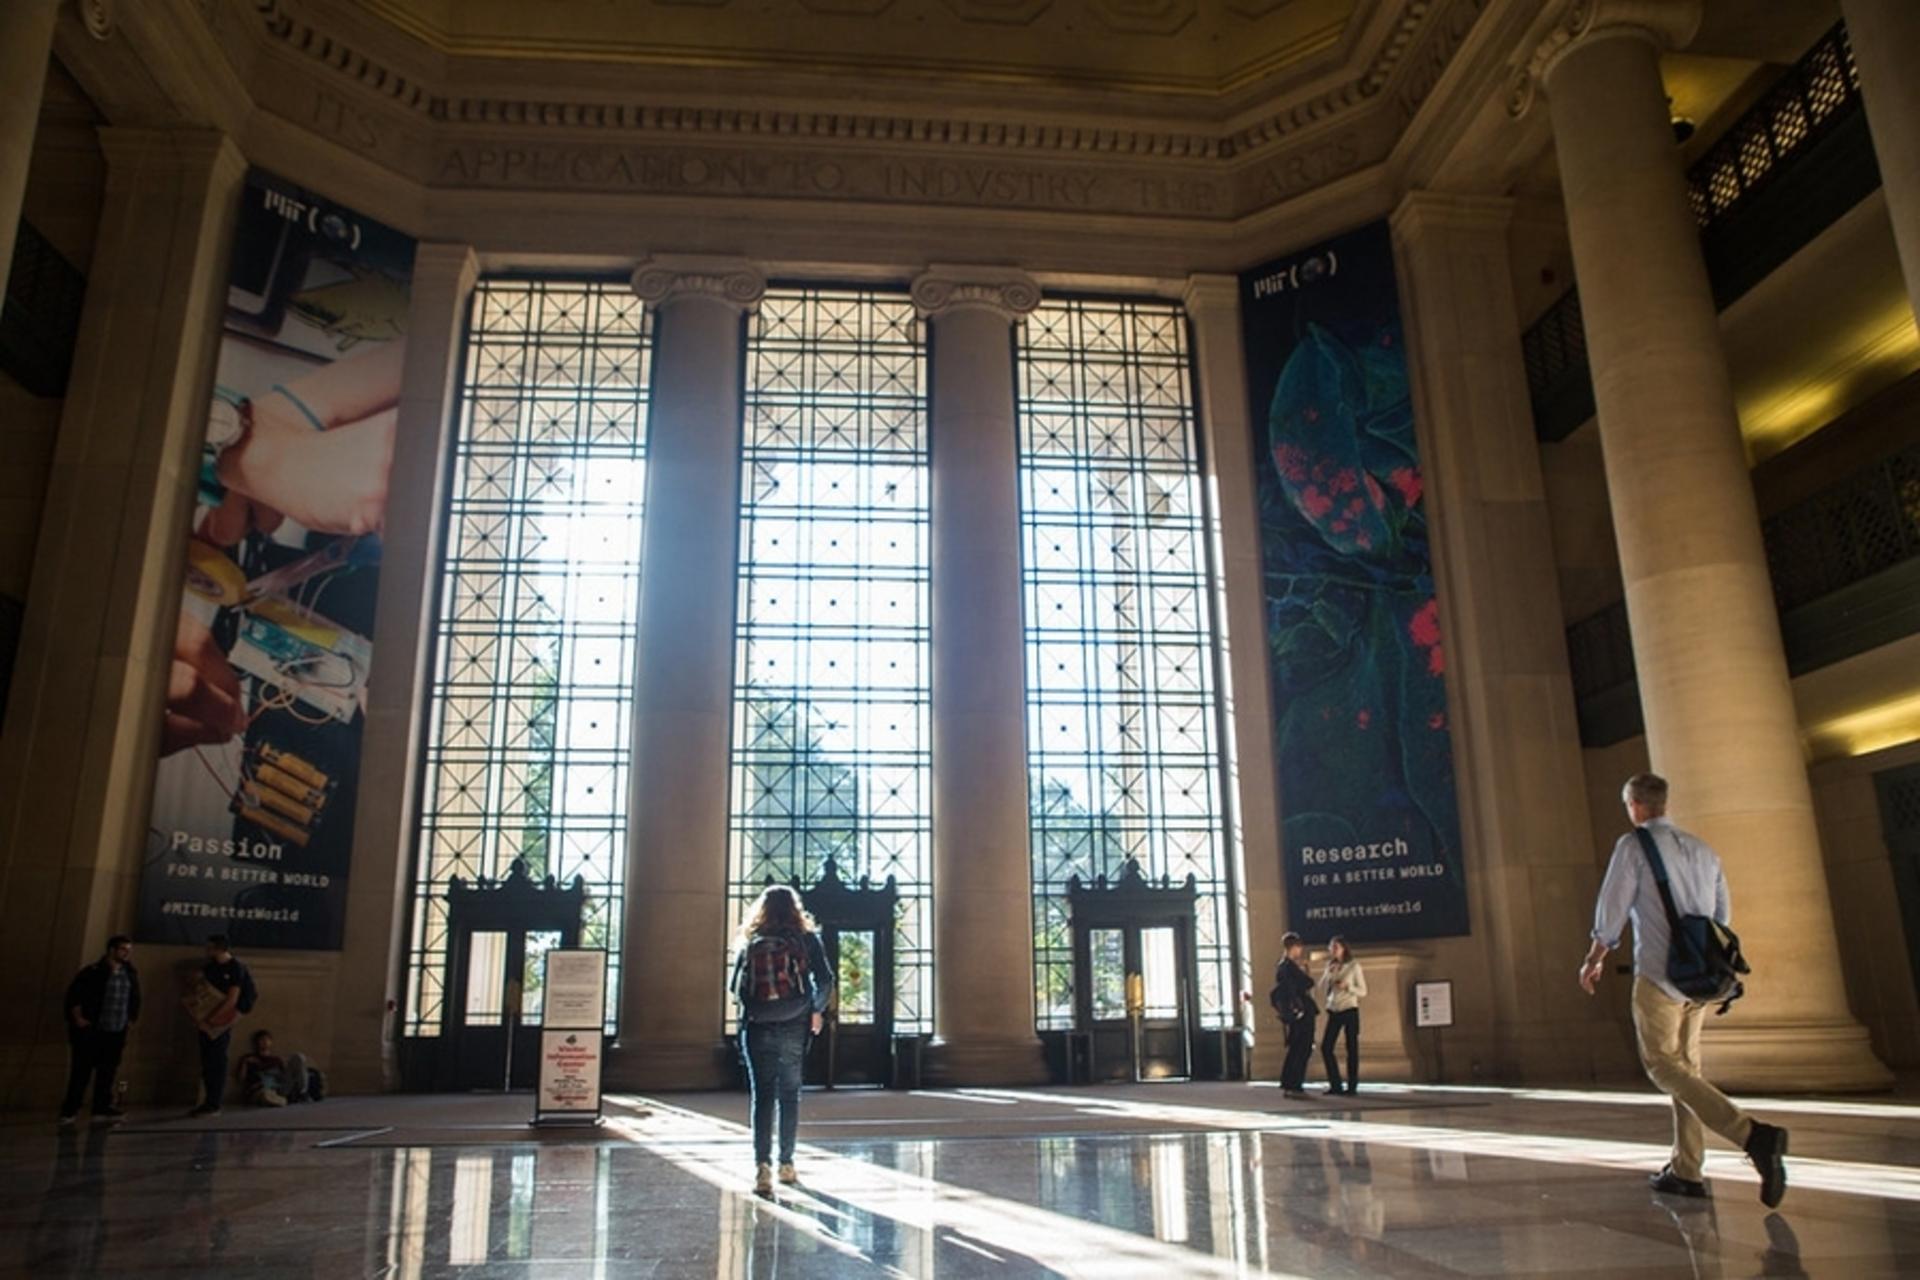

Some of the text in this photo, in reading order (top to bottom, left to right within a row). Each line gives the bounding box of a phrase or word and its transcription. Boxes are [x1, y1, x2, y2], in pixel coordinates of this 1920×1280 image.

[783, 159, 845, 193] TO
[884, 161, 1098, 204] INDVSTRY
[170, 831, 284, 861] Passion
[1302, 837, 1409, 865] Research
[167, 863, 331, 889] FOR A BETTER WORLD
[1303, 863, 1444, 887] FOR A BETTER WORLD
[161, 901, 301, 923] #MITBetterWorld
[1306, 900, 1423, 920] #MITBetterWorld
